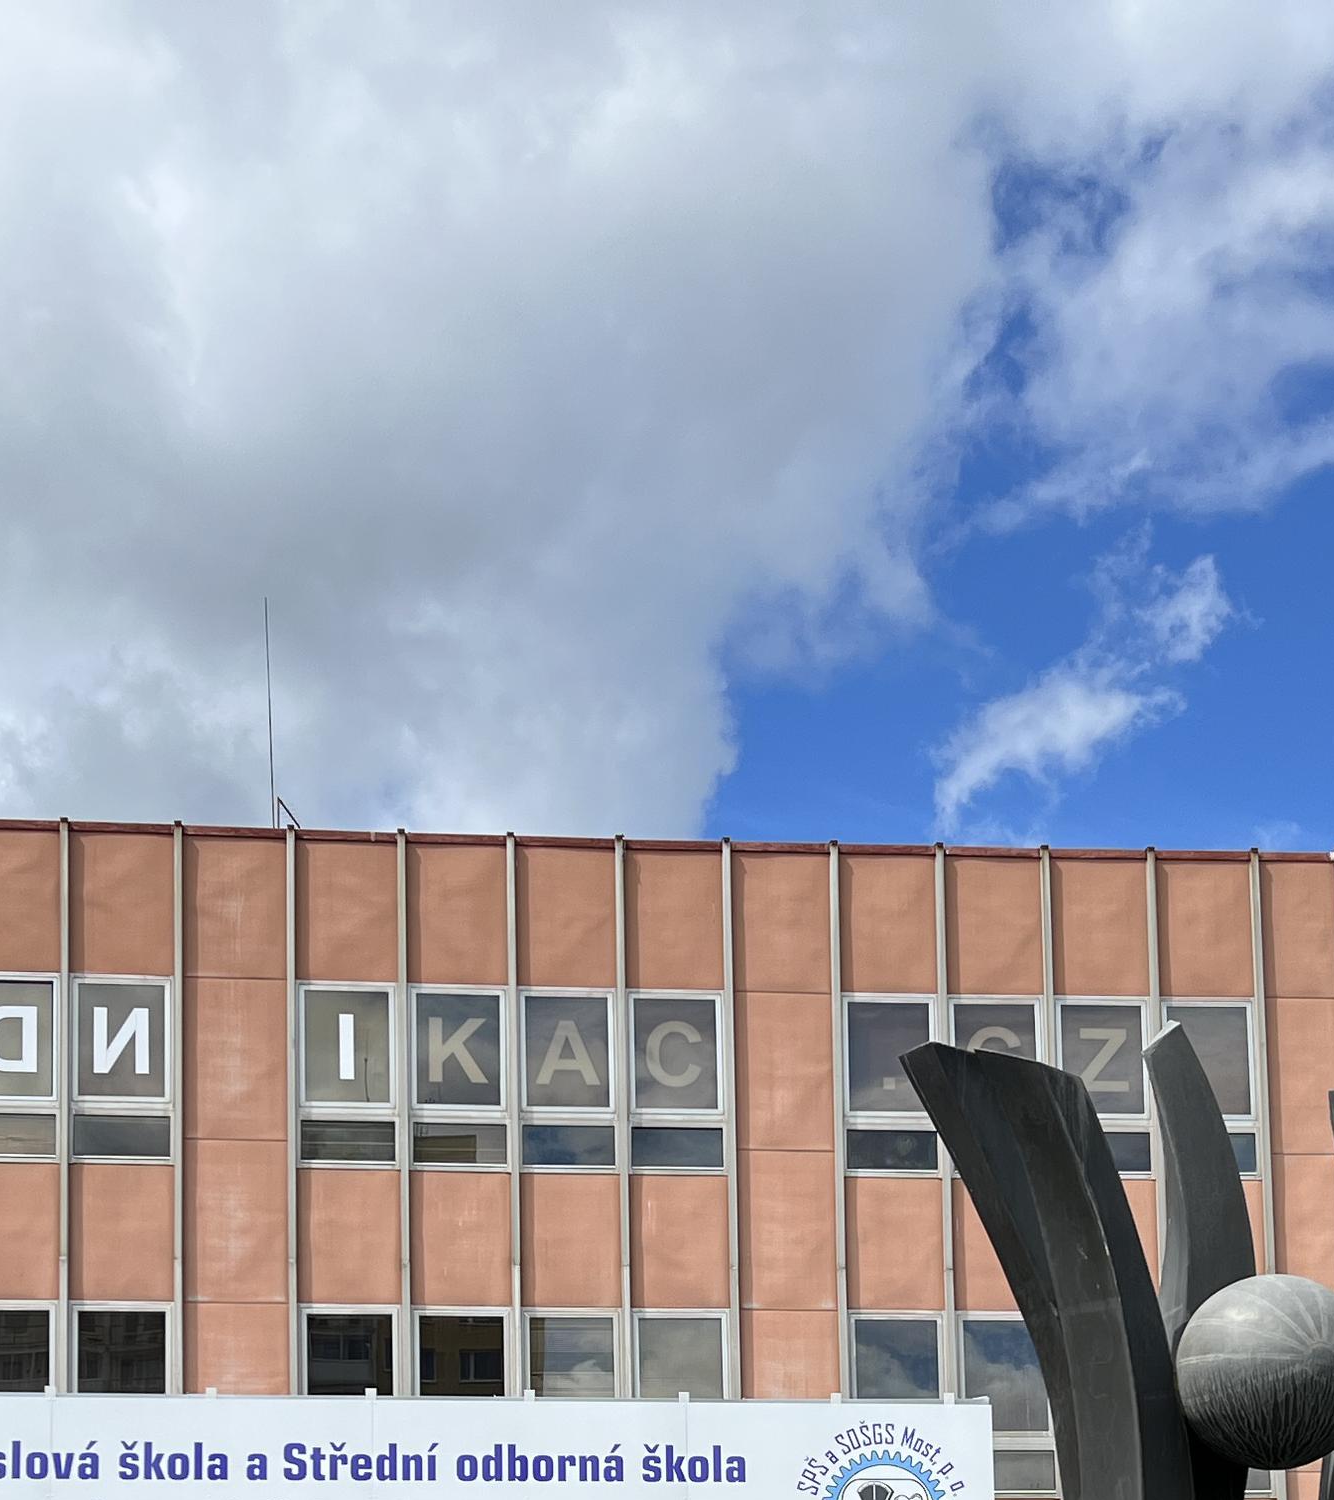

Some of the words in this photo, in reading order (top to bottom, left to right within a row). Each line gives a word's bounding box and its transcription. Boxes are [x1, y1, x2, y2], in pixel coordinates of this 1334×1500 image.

[118, 1440, 229, 1480] škola
[246, 1452, 268, 1480] a
[283, 1442, 439, 1481] Střední
[456, 1444, 624, 1482] odborná
[641, 1444, 747, 1483] škola
[796, 1456, 829, 1496] SPŠ
[825, 1450, 840, 1464] a
[834, 1420, 895, 1455] SOŠGS
[900, 1426, 941, 1466] Most,
